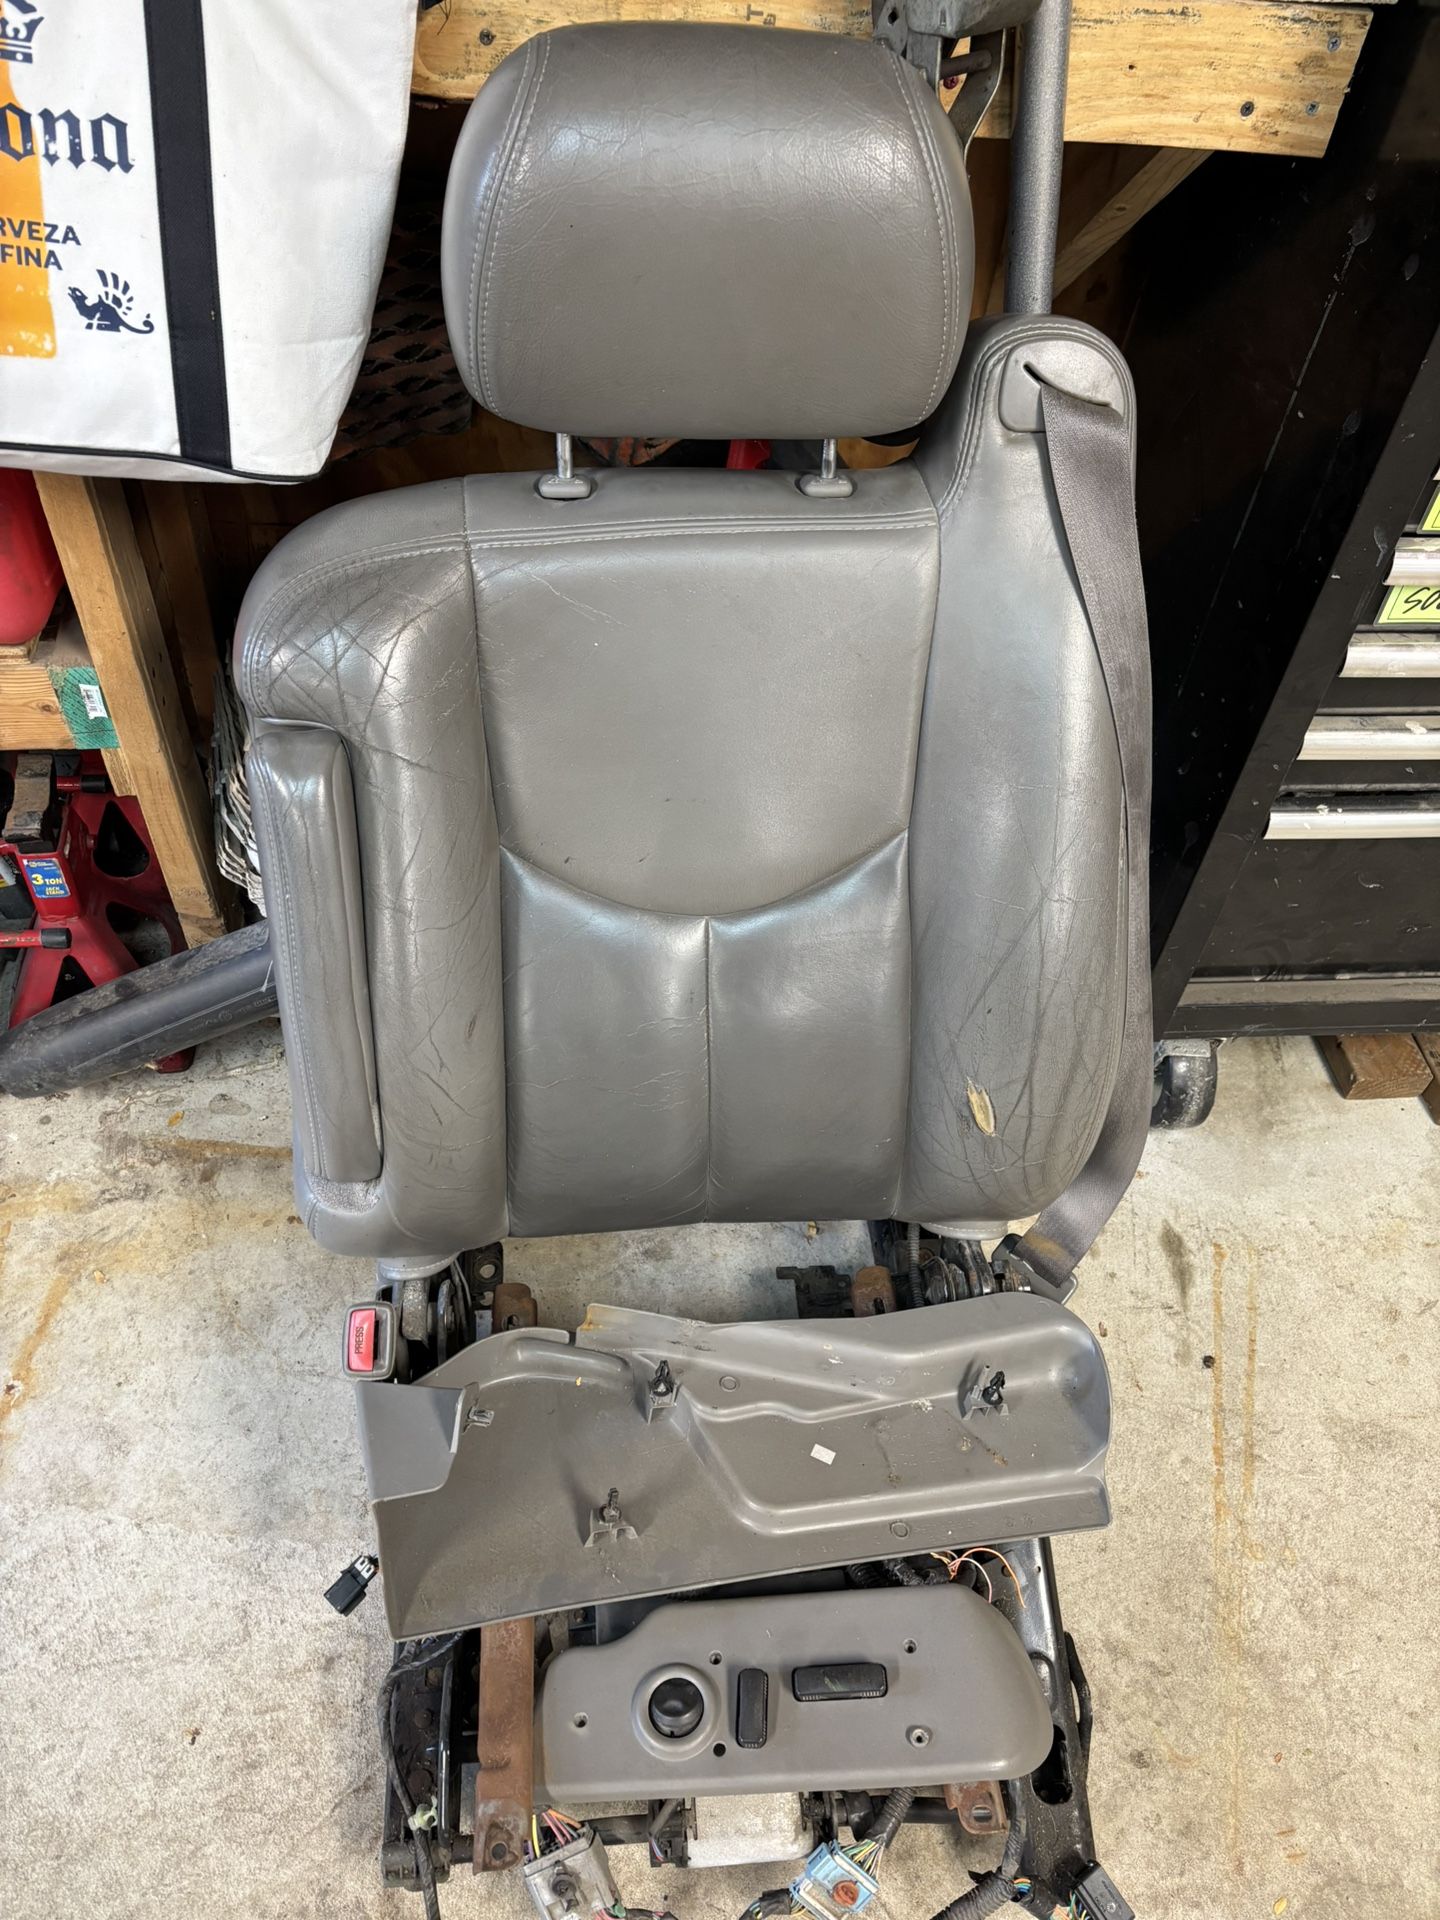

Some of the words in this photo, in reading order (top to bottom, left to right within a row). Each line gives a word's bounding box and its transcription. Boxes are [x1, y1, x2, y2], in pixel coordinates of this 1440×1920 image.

[0, 102, 135, 174] ona
[0, 243, 63, 271] FINA
[31, 873, 44, 885] 3
[354, 1326, 364, 1354] PRESS
